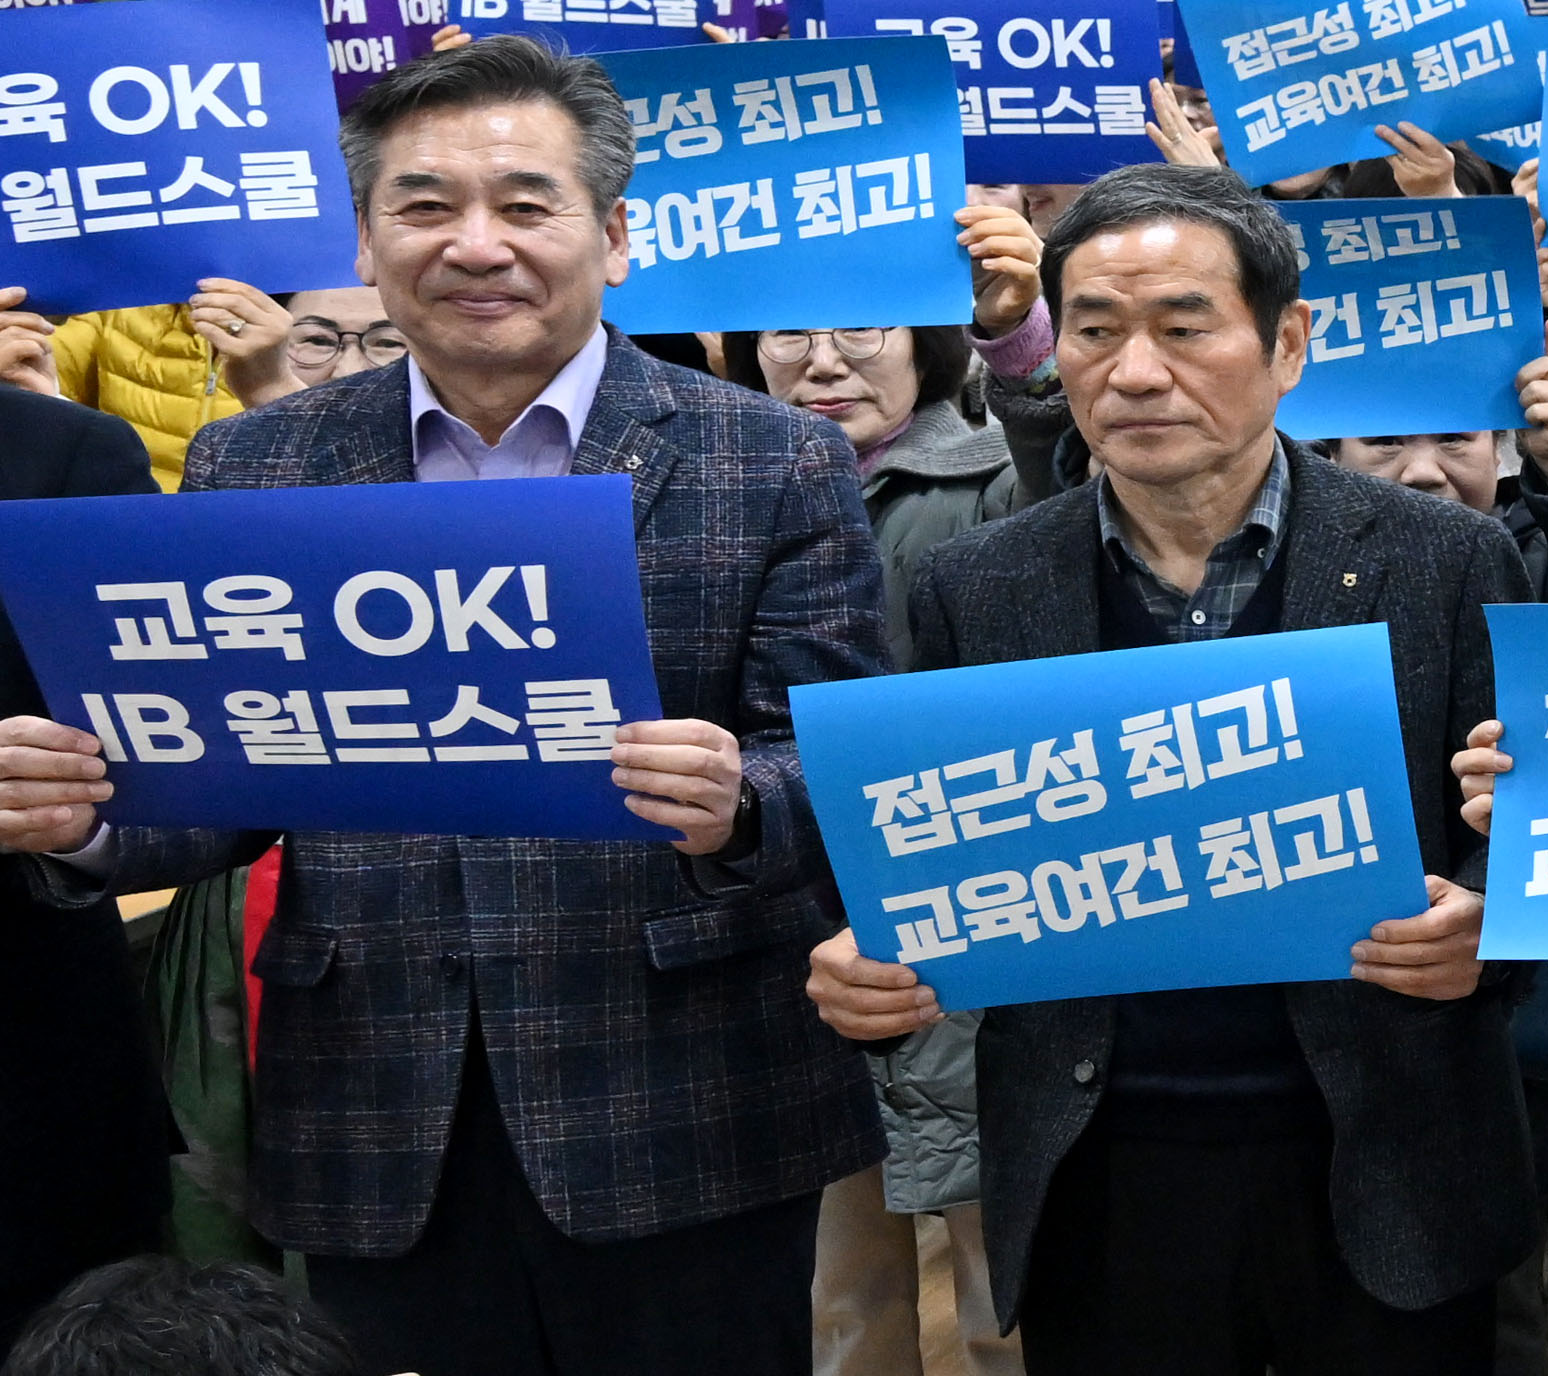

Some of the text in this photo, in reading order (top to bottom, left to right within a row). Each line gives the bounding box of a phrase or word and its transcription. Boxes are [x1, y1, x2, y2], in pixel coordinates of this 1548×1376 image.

[996, 17, 1115, 70] OK!
[1221, 0, 1361, 83] 접근성
[88, 61, 268, 136] OK!
[733, 64, 882, 145] 최고!
[1234, 18, 1516, 154] 교육여건 최고!
[1, 151, 321, 245] 월드스쿨
[791, 152, 935, 240] 최고!
[1325, 209, 1459, 268] 최고!
[1377, 268, 1515, 353] 최고!
[93, 562, 559, 664] 교육 OK!
[79, 677, 622, 767] IB 월드스쿨
[861, 676, 1305, 860] 접근성 최고!
[879, 785, 1381, 967] 교육여건 최고!
